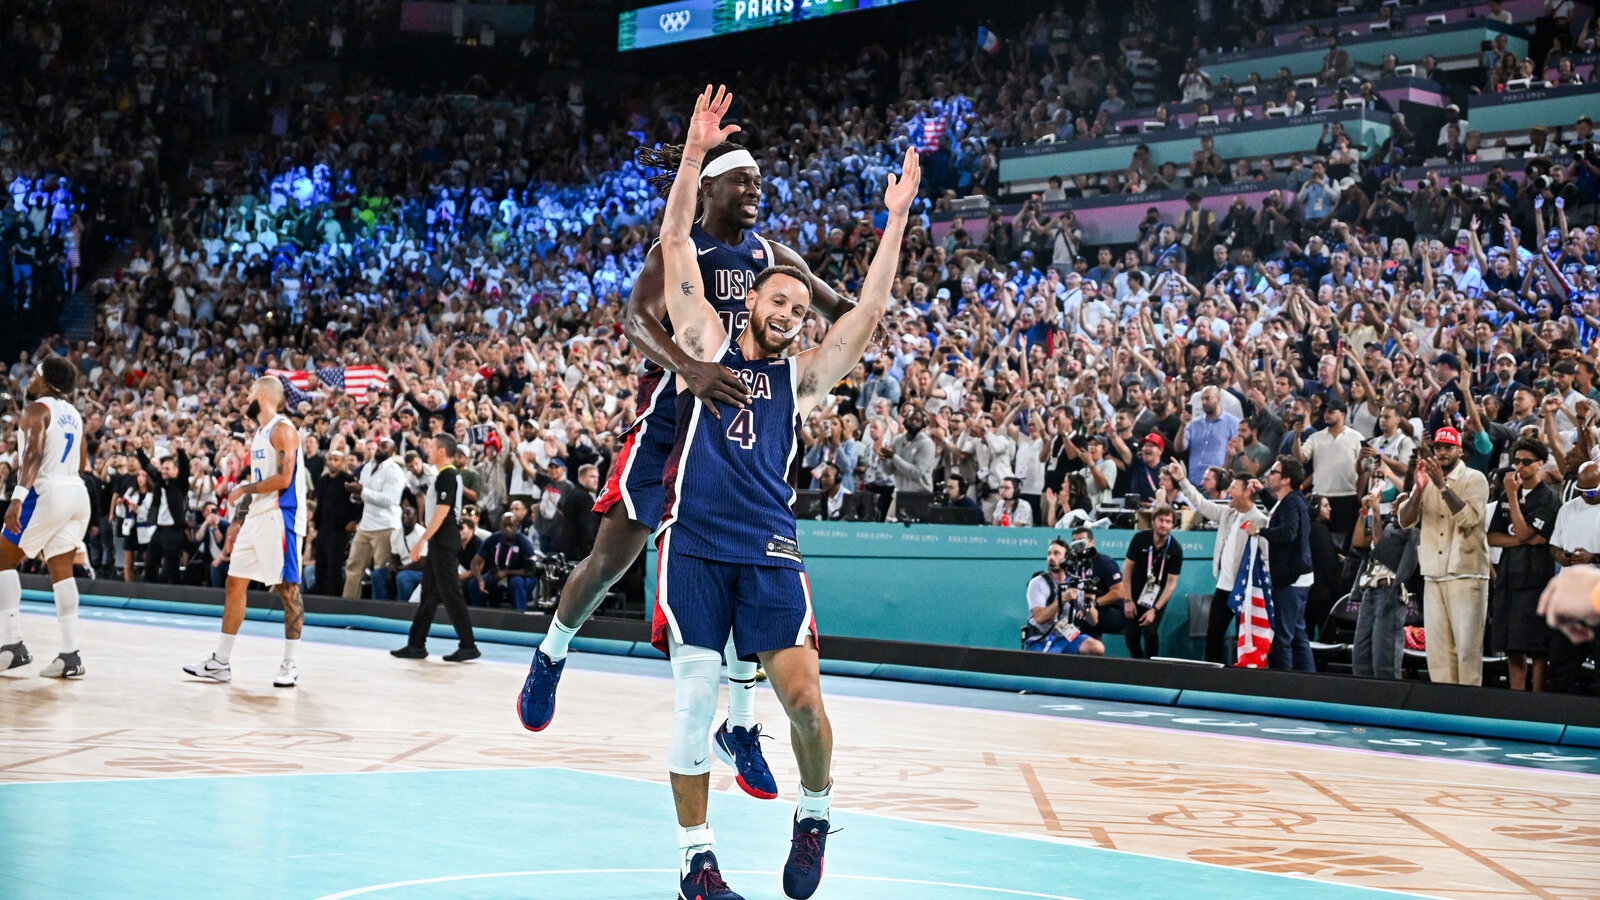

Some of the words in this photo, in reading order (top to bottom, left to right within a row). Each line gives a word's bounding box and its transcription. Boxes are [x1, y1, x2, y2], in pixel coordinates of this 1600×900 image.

[734, 0, 794, 21] PARIS
[726, 367, 772, 400] SA
[727, 408, 756, 449] 4
[60, 432, 75, 463] 7
[1532, 517, 1545, 531] 31
